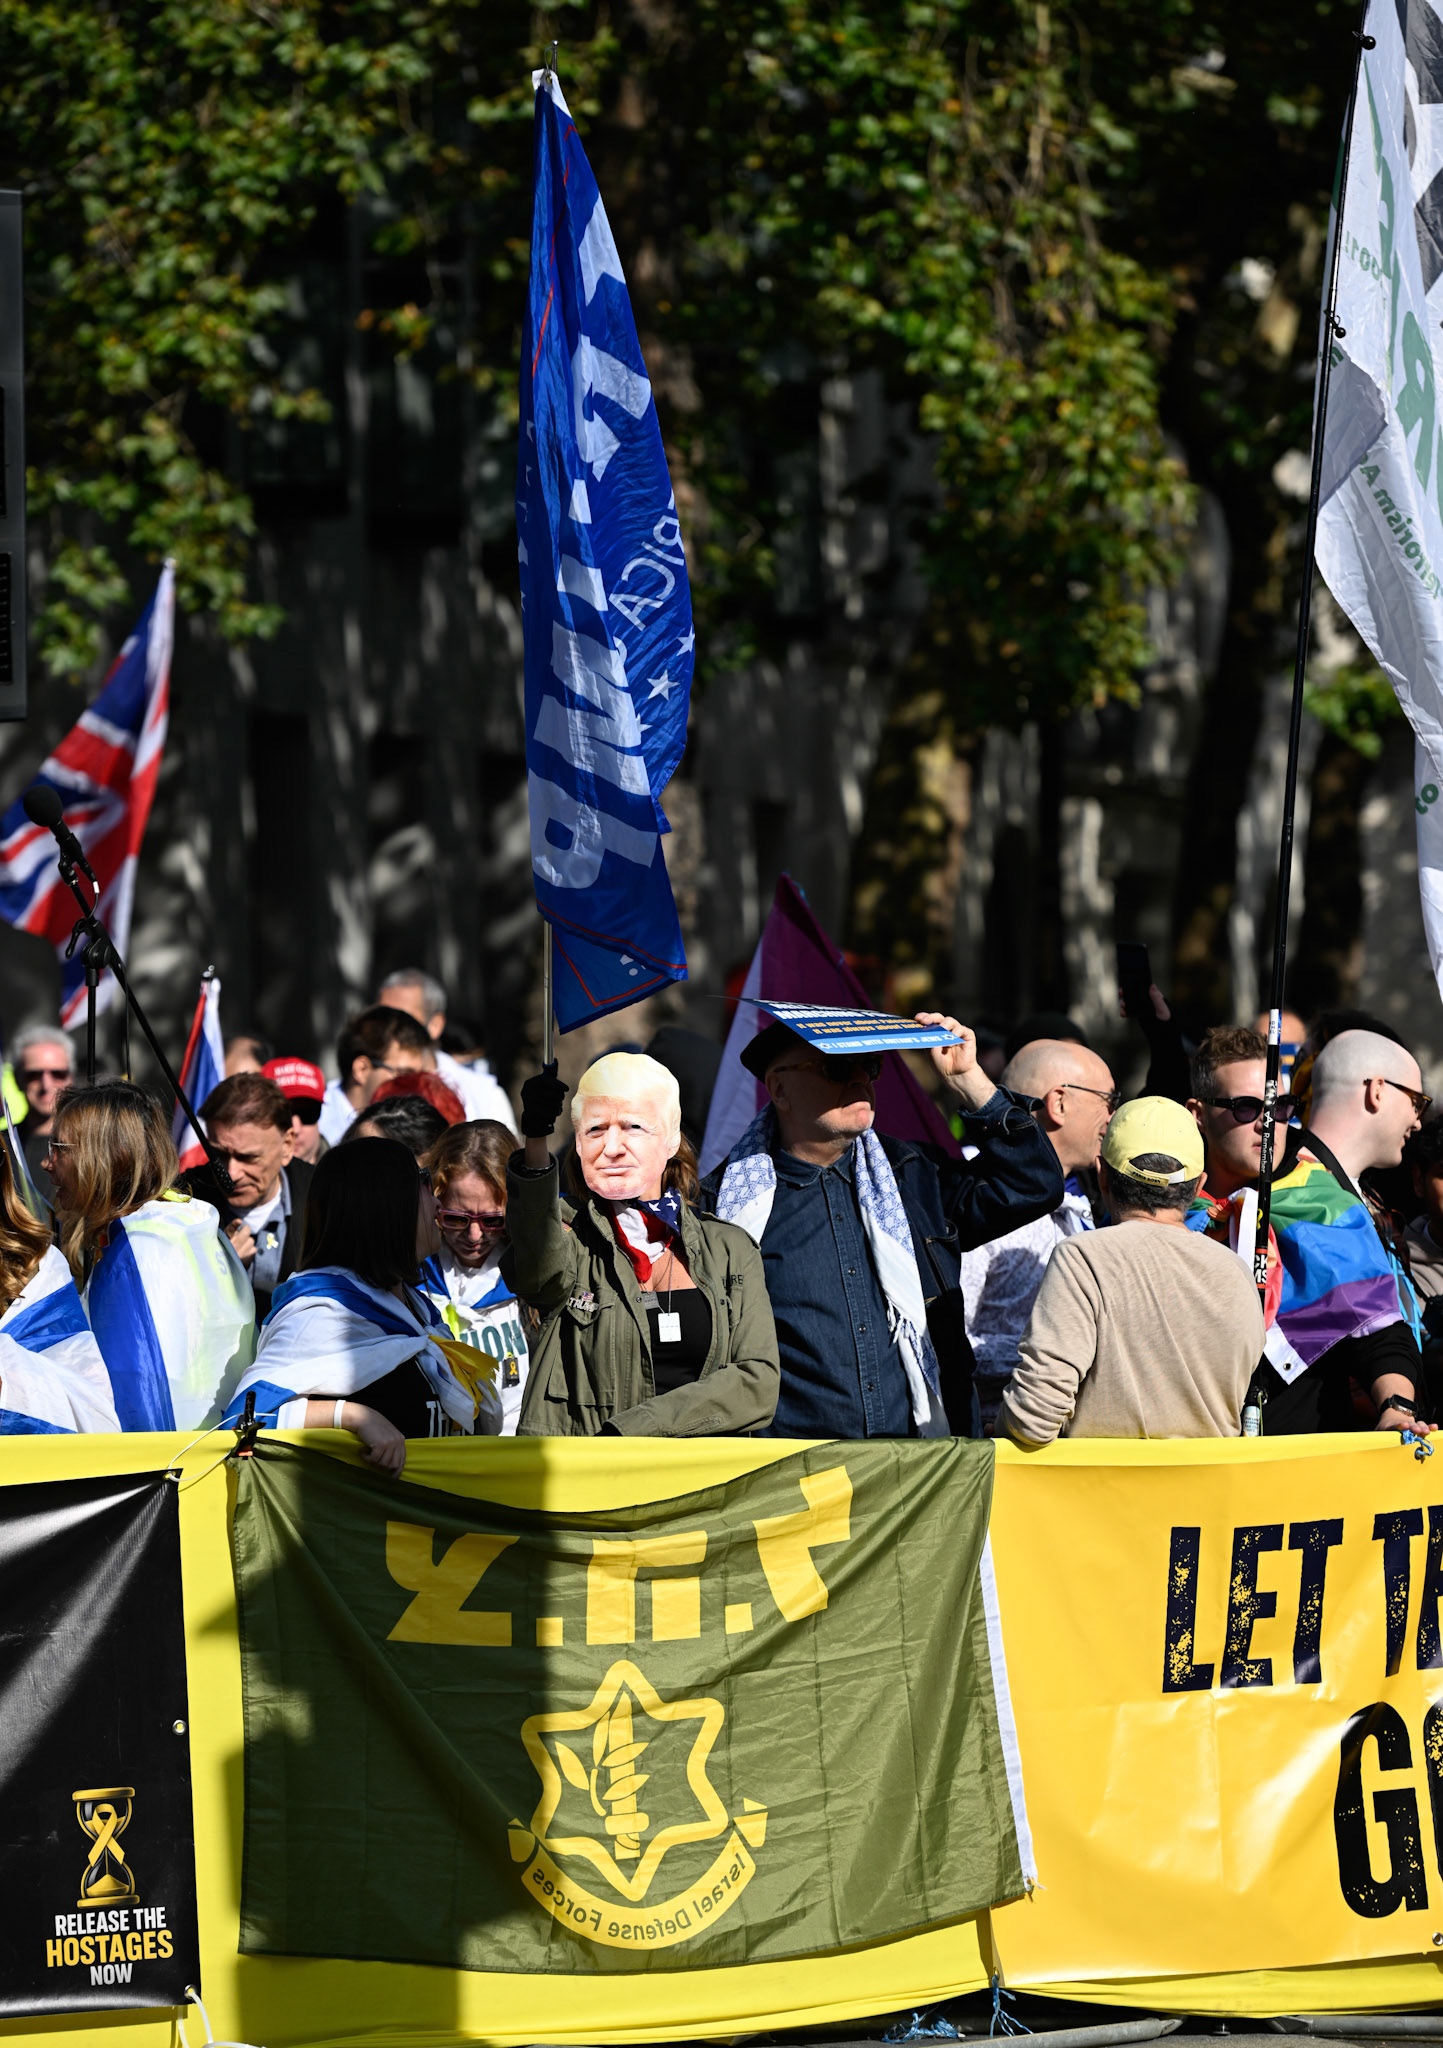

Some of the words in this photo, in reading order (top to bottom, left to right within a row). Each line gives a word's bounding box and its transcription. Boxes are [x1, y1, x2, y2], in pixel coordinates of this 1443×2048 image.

[1260, 1132, 1270, 1174] Remember
[1162, 1517, 1344, 1693] LET
[1334, 1695, 1443, 1919] G
[55, 1909, 130, 1936] RELEASE
[132, 1906, 167, 1930] THE
[46, 1929, 174, 1968] HOSTAGES
[90, 1963, 133, 1986] NOW
